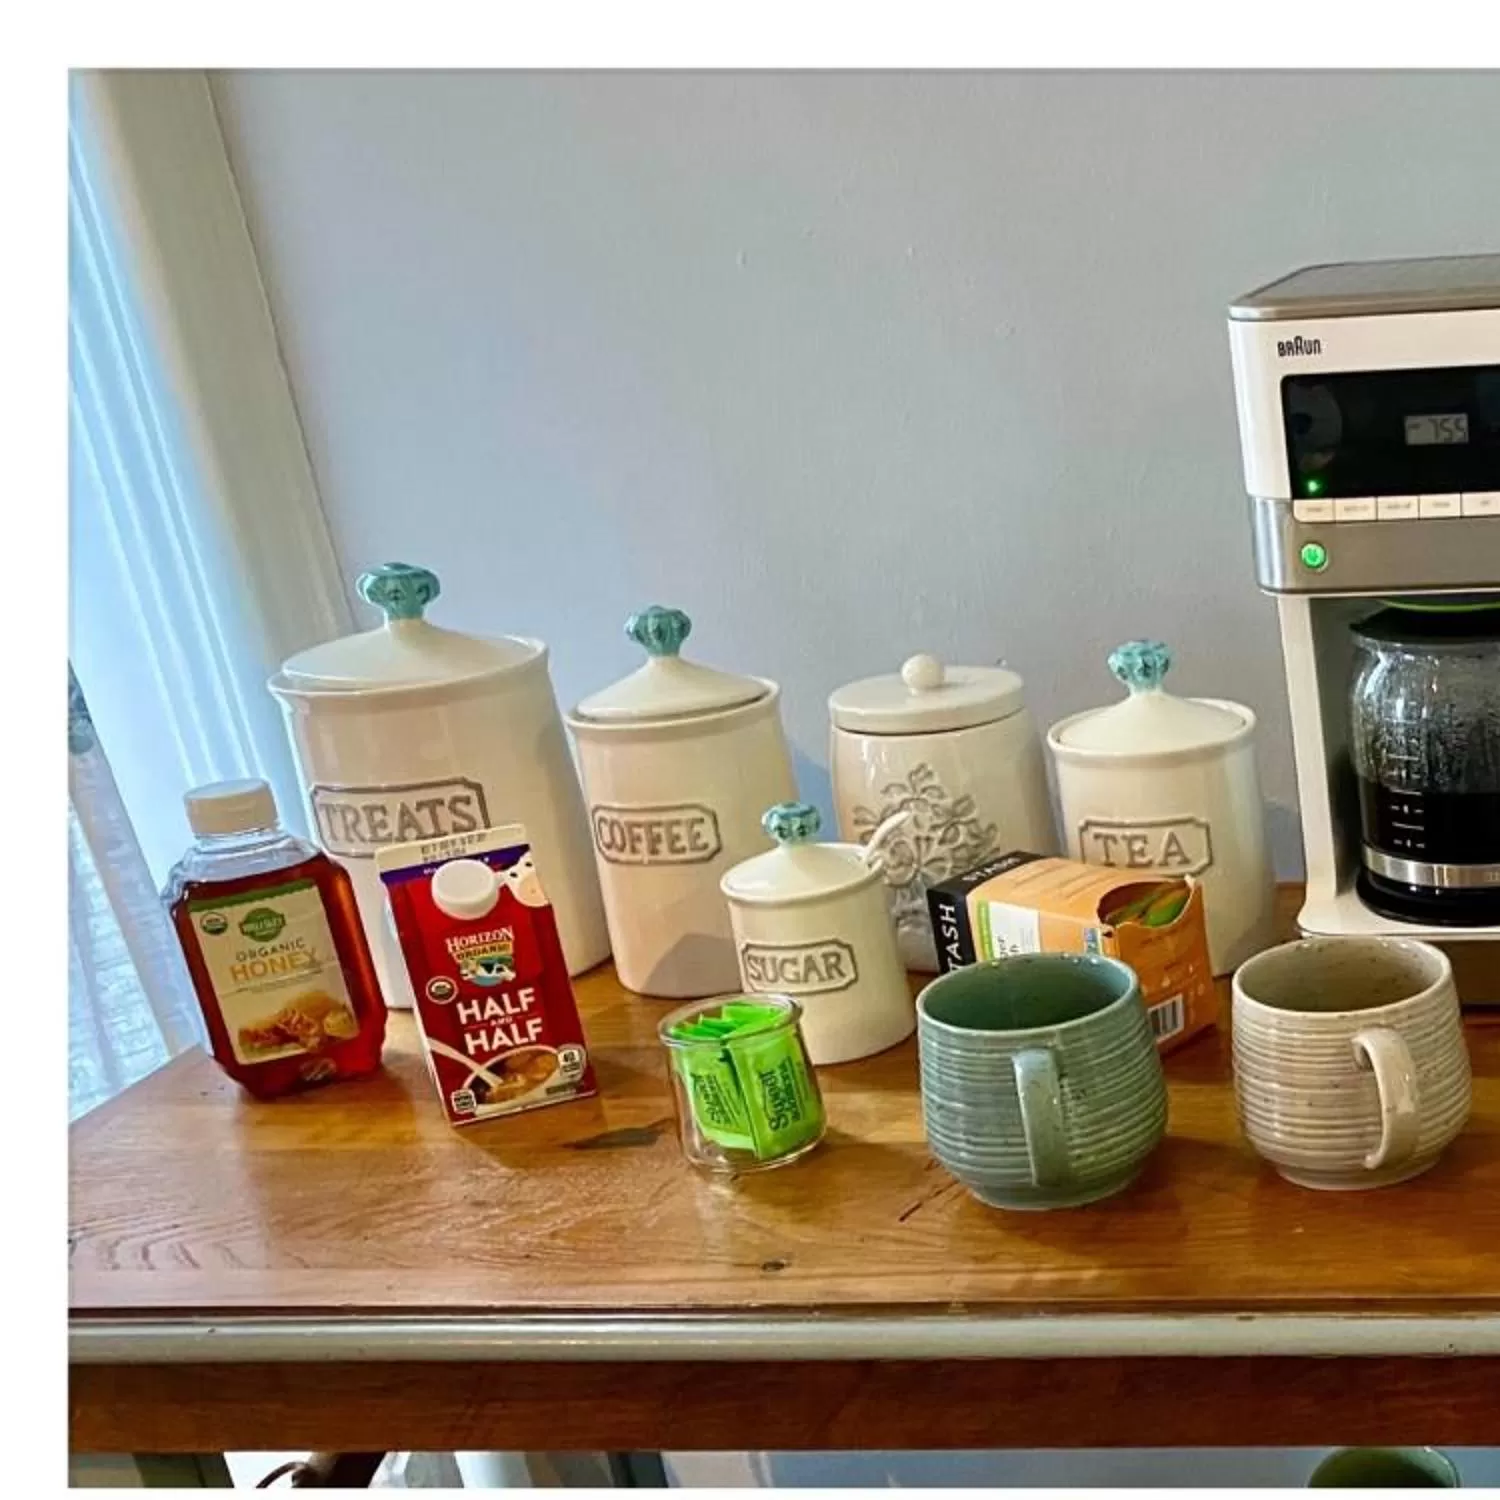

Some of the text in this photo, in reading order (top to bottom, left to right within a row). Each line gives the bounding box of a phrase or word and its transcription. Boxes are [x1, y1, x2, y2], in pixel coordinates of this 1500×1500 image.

[1277, 335, 1321, 357] BRAUN
[318, 795, 477, 843] TREATS
[598, 815, 710, 856] COFFEE
[1093, 831, 1191, 867] TEA
[235, 936, 305, 962] ORGANIC
[446, 925, 515, 954] HORIZON
[938, 903, 966, 972] TASH
[230, 947, 318, 983] HONEY
[747, 951, 848, 984] SUGAR
[456, 987, 536, 1025] HALF
[464, 1016, 544, 1056] HALF
